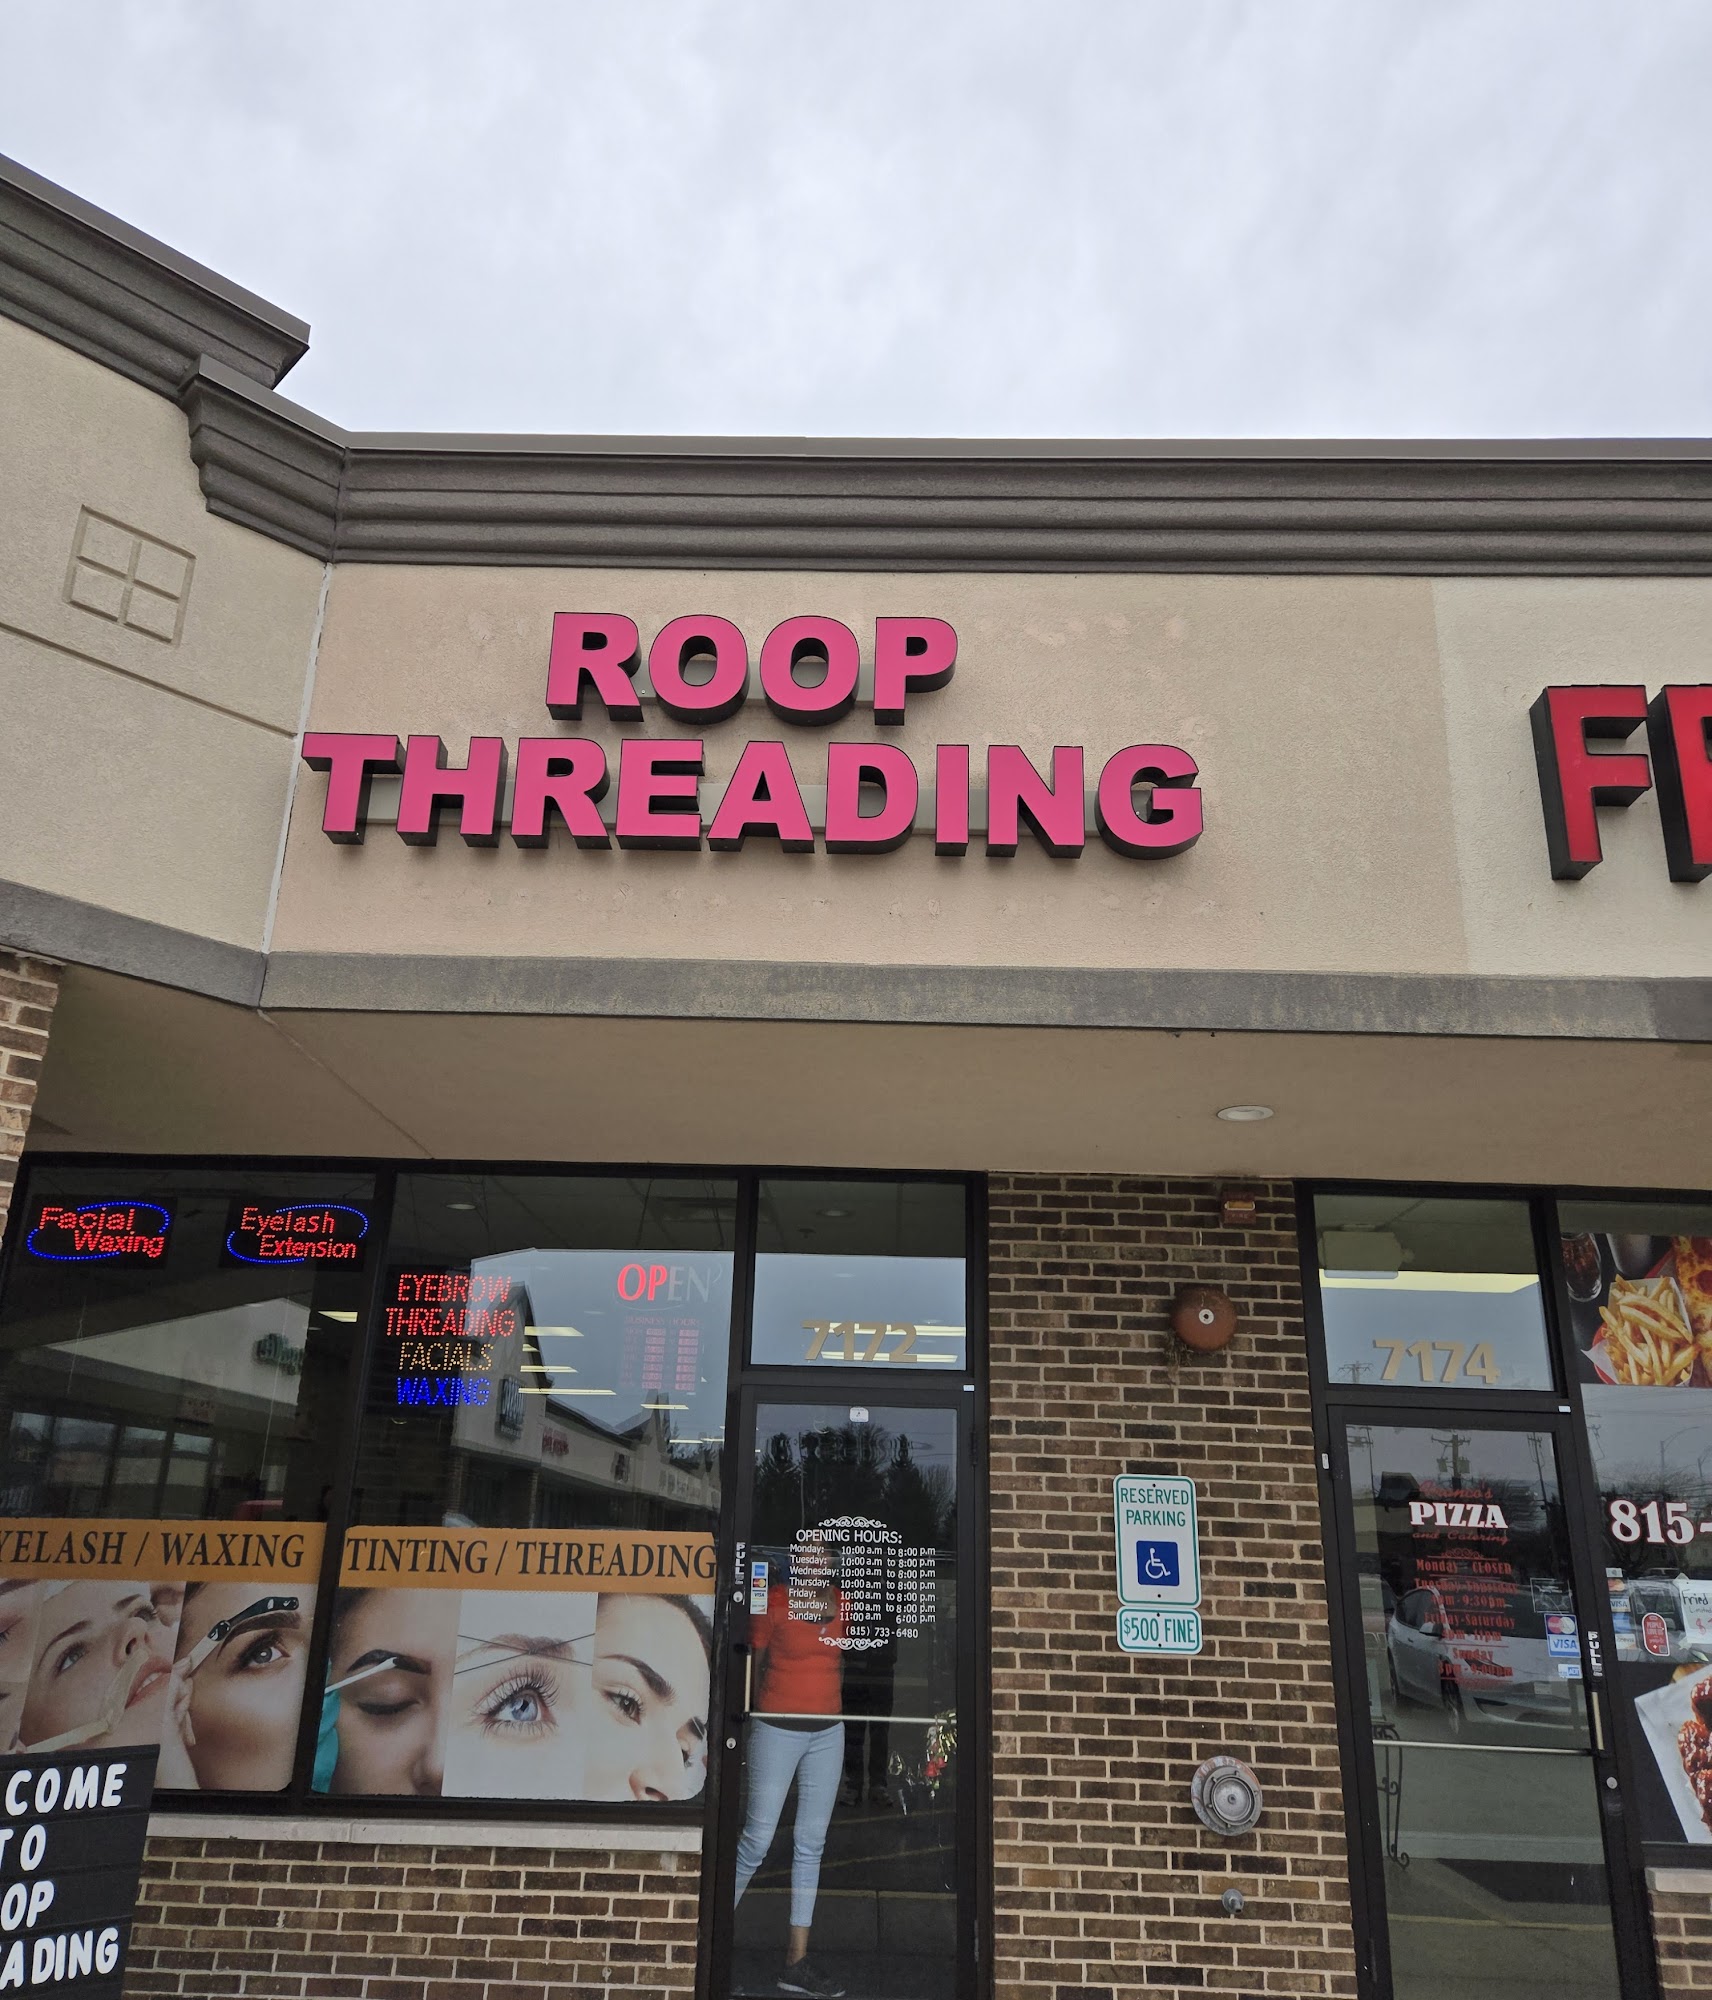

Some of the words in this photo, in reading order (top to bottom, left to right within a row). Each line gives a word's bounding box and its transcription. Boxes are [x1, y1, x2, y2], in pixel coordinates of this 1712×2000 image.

[546, 612, 958, 726] ROOP
[302, 732, 1204, 860] THREADING
[39, 1207, 135, 1232] Facial
[240, 1206, 336, 1235] Eyelash
[73, 1230, 165, 1258] Waxing
[259, 1234, 357, 1259] Extension
[397, 1273, 512, 1303] EYEBROW
[617, 1263, 711, 1303] OPEN
[386, 1307, 515, 1337] THREADING
[803, 1320, 917, 1362] 7172
[399, 1342, 494, 1371] FACIALS
[1373, 1339, 1499, 1384] 7174
[397, 1377, 490, 1406] WAXING
[1120, 1487, 1189, 1505] RESERVED
[1126, 1509, 1186, 1527] PARKING
[1408, 1501, 1509, 1529] PIZZA
[160, 1532, 304, 1568] WAXING
[790, 1544, 825, 1554] Monday:
[841, 1546, 865, 1555] 10:00
[866, 1547, 882, 1555] a.m
[887, 1547, 896, 1556] to
[897, 1548, 918, 1557] 8:00
[919, 1547, 936, 1556] p.m
[796, 1529, 850, 1542] OPENING
[854, 1529, 903, 1544] HOURS:
[346, 1537, 489, 1574] TINTING
[516, 1541, 716, 1579] THREADING
[735, 1541, 746, 1575] PULL
[790, 1555, 827, 1566] Tuesday:
[841, 1557, 865, 1567] 10:00
[866, 1558, 882, 1566] a.m
[887, 1558, 896, 1567] to
[898, 1559, 918, 1568] 8:00
[919, 1559, 936, 1568] p.m
[1416, 1559, 1457, 1574] Monday
[1472, 1560, 1512, 1575] CLOSED
[789, 1566, 839, 1577] Wednesday:
[840, 1568, 865, 1577] 10:00
[866, 1568, 882, 1576] a.m
[886, 1569, 896, 1578] to
[897, 1570, 918, 1579] 8:00
[919, 1570, 936, 1579] p.m
[789, 1577, 830, 1588] Thursday:
[840, 1579, 865, 1589] 10:00
[865, 1581, 882, 1589] a.m
[886, 1580, 896, 1589] to
[897, 1581, 918, 1591] 8:00
[919, 1582, 936, 1591] p.m
[788, 1588, 816, 1599] Friday:
[840, 1591, 865, 1600] 10:00
[865, 1591, 882, 1600] a.m
[886, 1592, 896, 1601] to
[896, 1593, 918, 1602] 8:00
[919, 1594, 936, 1603] p.m
[788, 1599, 828, 1611] Saturday:
[840, 1602, 865, 1611] 10:00
[865, 1603, 881, 1612] a.m
[885, 1603, 895, 1612] to
[896, 1604, 918, 1613] 8:00
[919, 1604, 936, 1614] p.m
[1682, 1588, 1709, 1606] Fried
[788, 1611, 821, 1622] Sunday:
[840, 1612, 864, 1622] 11:00
[865, 1612, 882, 1621] a.m
[895, 1614, 918, 1624] 6:00
[919, 1614, 936, 1624] p.m
[845, 1626, 871, 1636] (815)
[1123, 1617, 1159, 1642] $500
[1165, 1618, 1196, 1643] FINE
[1453, 1648, 1493, 1663] Sunday
[1553, 1640, 1578, 1650] VISA
[1588, 1631, 1602, 1667] PULL
[5, 1763, 127, 1817] COME
[1, 1880, 54, 1931] OP
[0, 1928, 119, 1991] ADING
